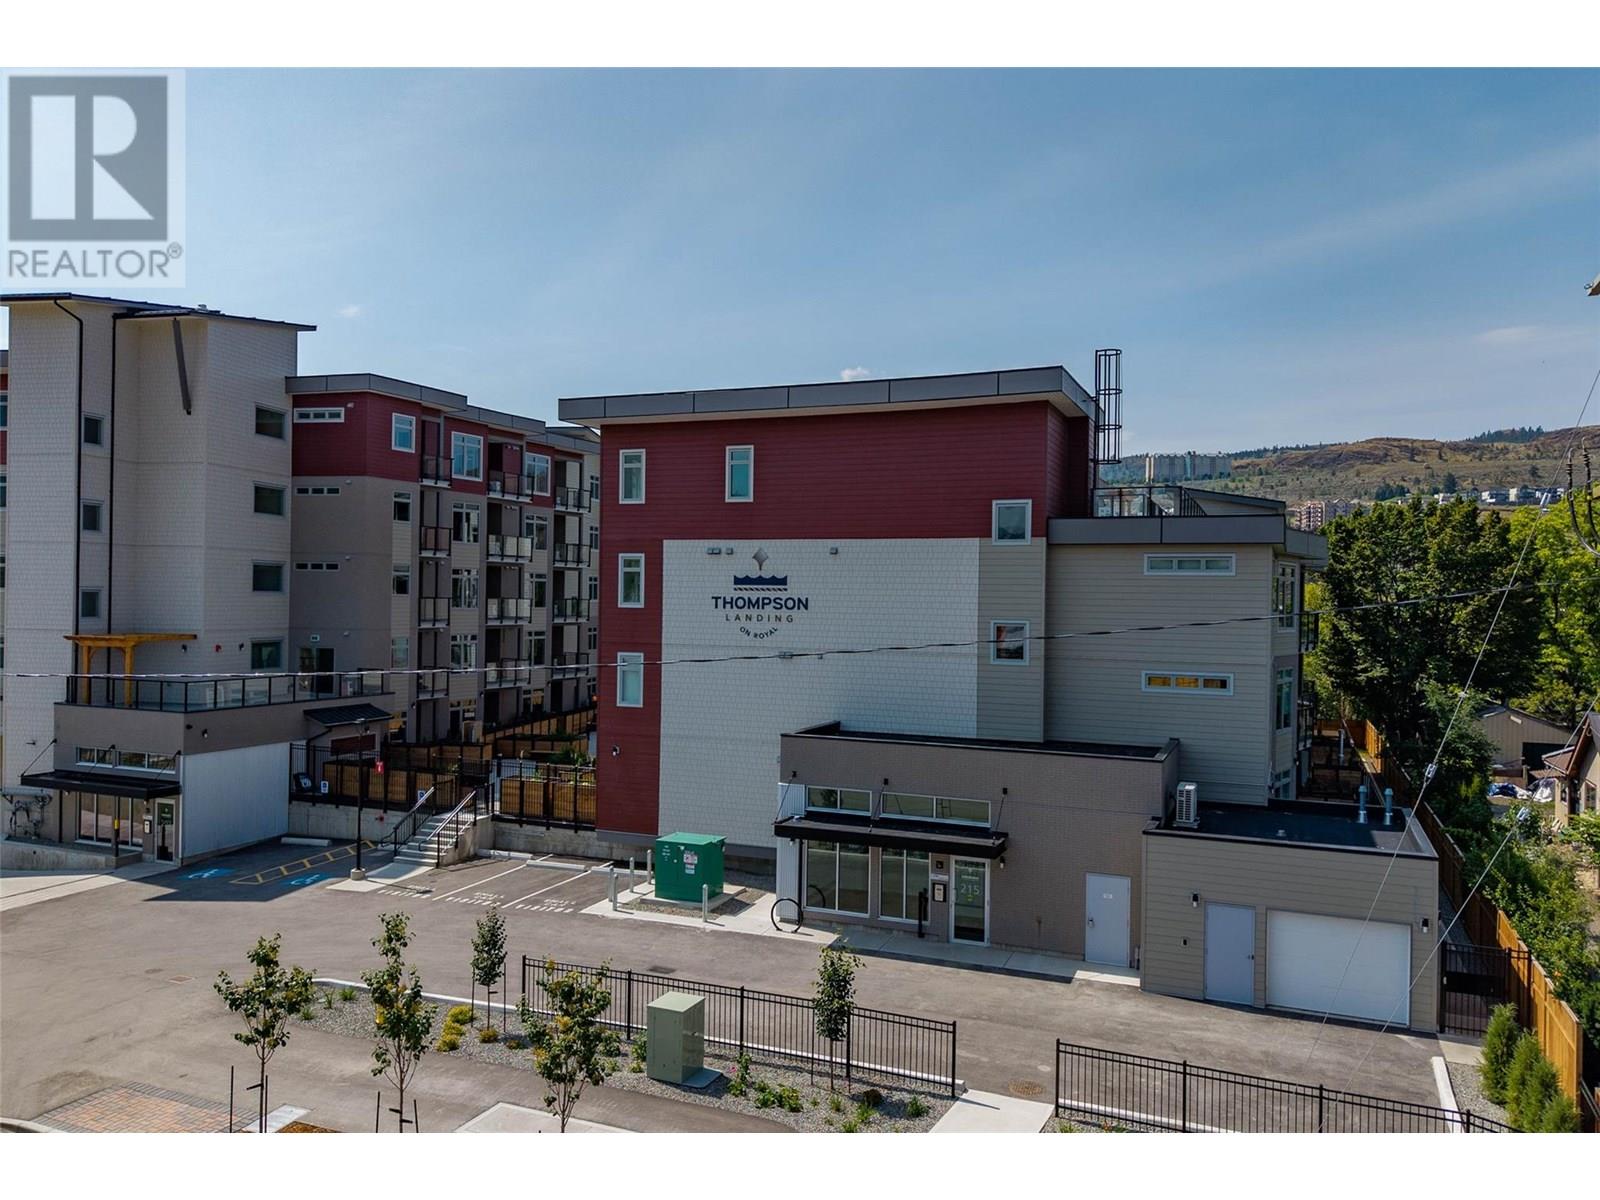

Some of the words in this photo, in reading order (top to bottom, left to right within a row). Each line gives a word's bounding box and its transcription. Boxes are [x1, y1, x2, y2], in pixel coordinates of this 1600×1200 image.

[711, 596, 809, 611] THOMPSON
[725, 613, 794, 623] LANDING
[739, 626, 751, 637] ON
[753, 626, 778, 640] ROYAL
[960, 883, 980, 896] 215
